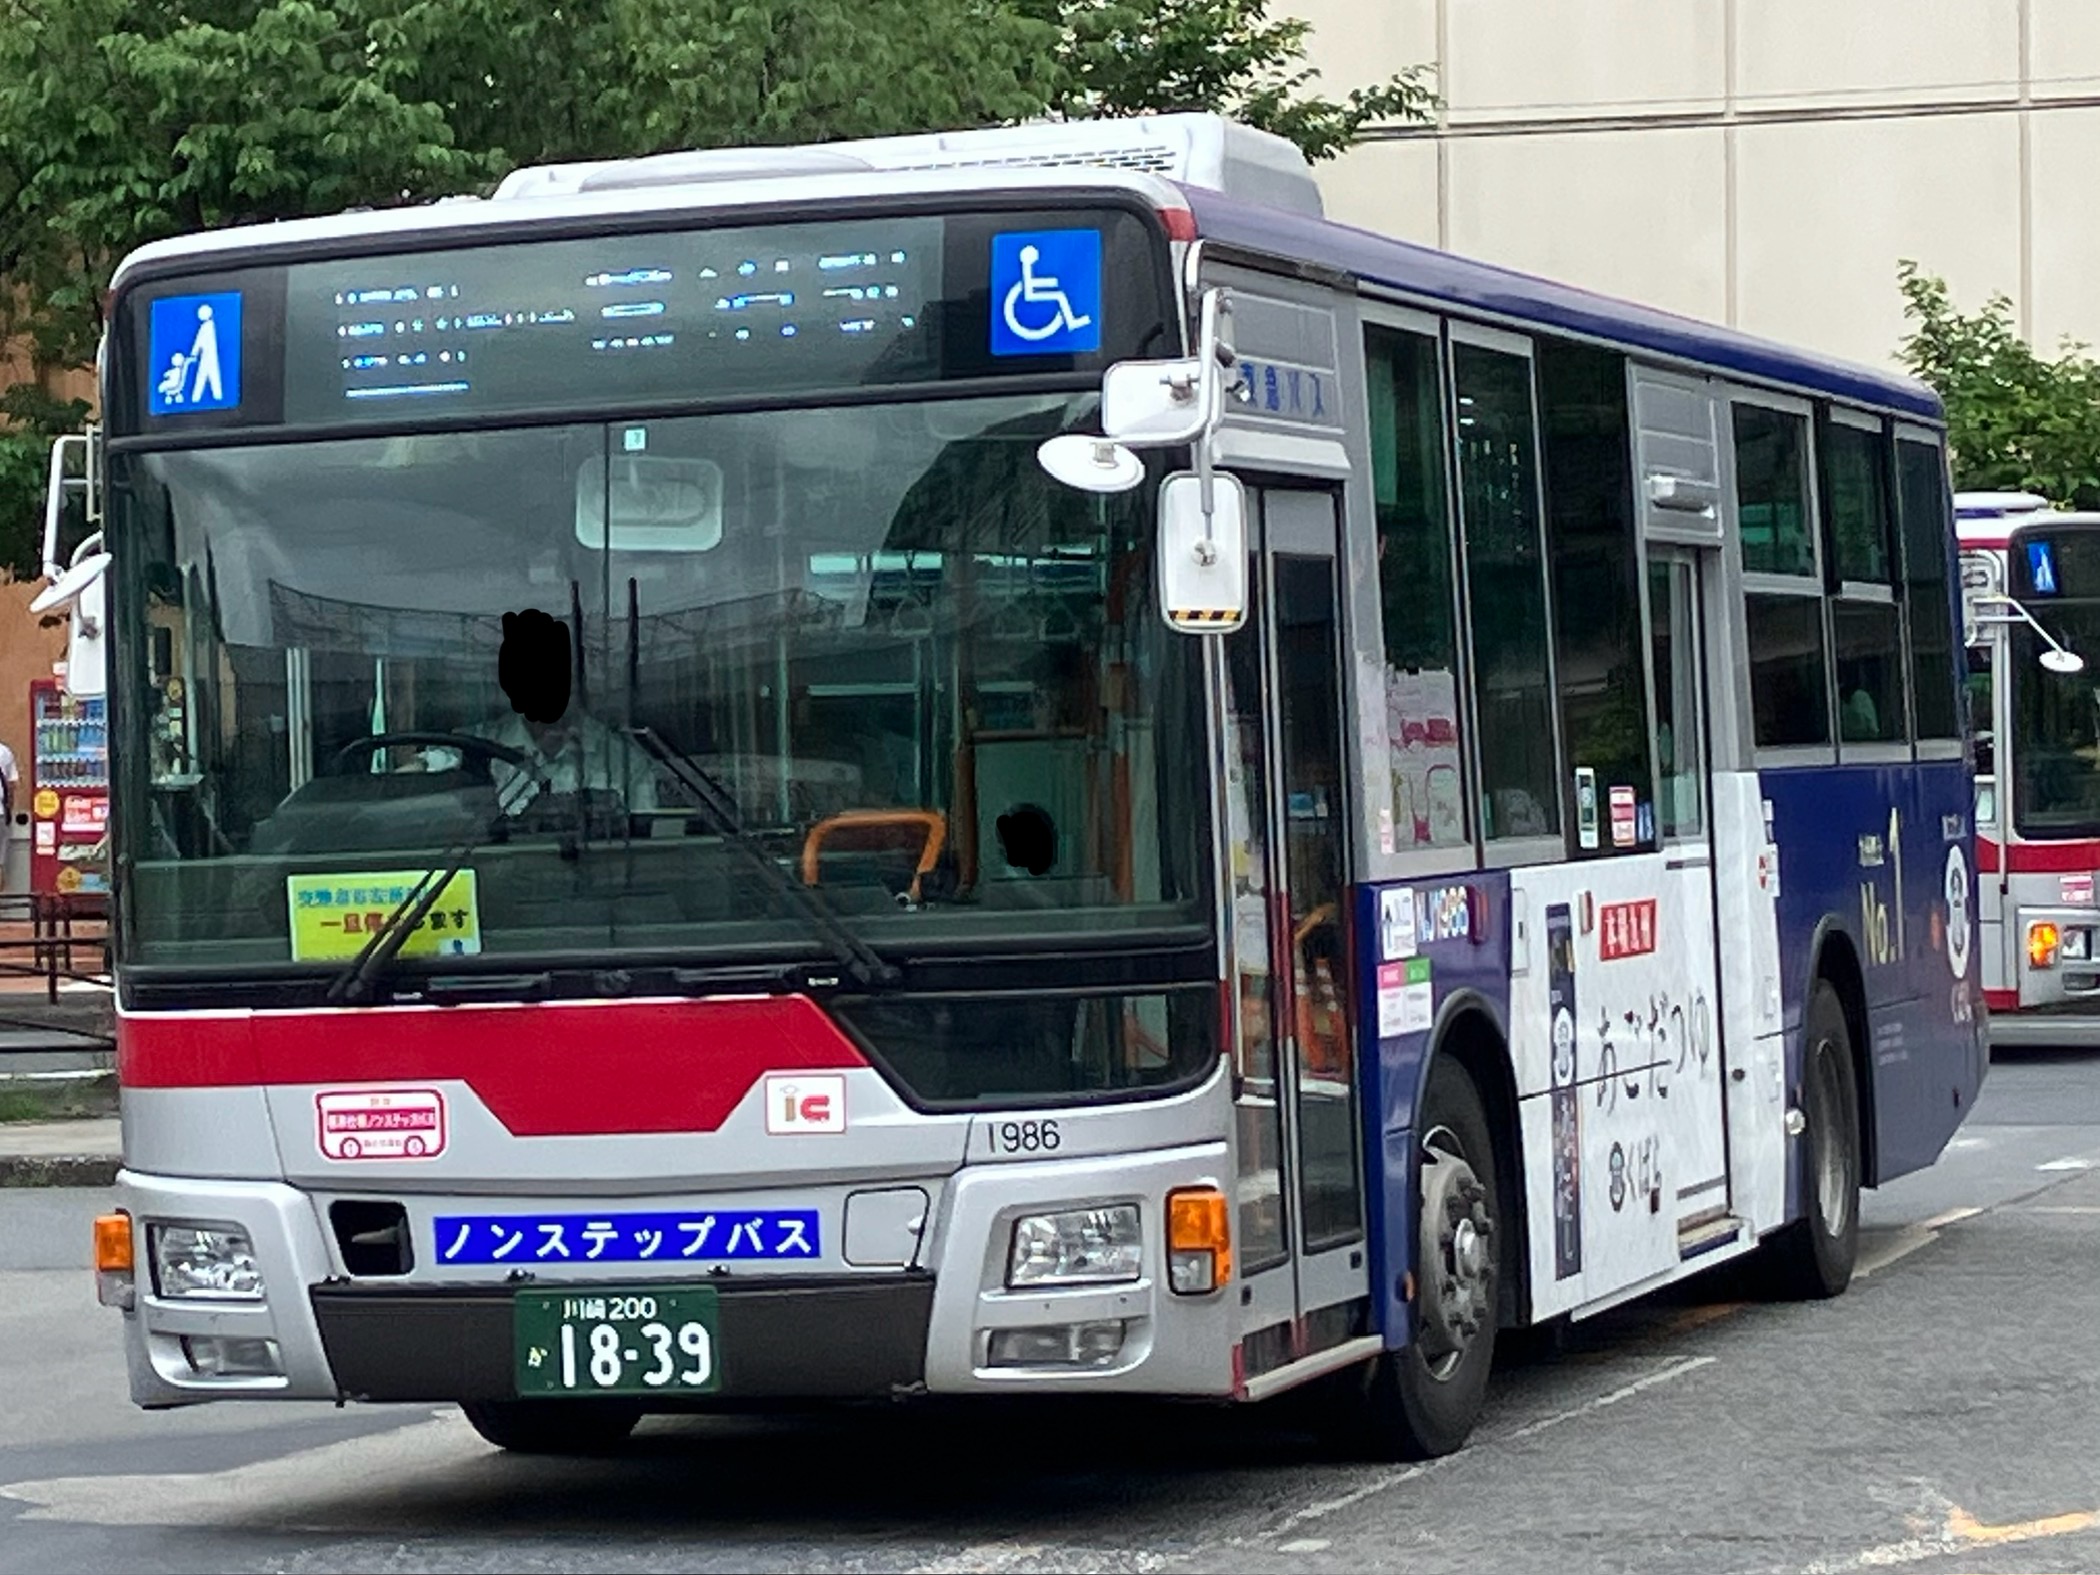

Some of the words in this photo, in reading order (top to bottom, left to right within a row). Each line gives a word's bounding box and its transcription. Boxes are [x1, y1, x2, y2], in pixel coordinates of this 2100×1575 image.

[987, 1118, 1061, 1154] 1986
[444, 1215, 812, 1259] ノンステップバス
[560, 1321, 713, 1389] 18-39
